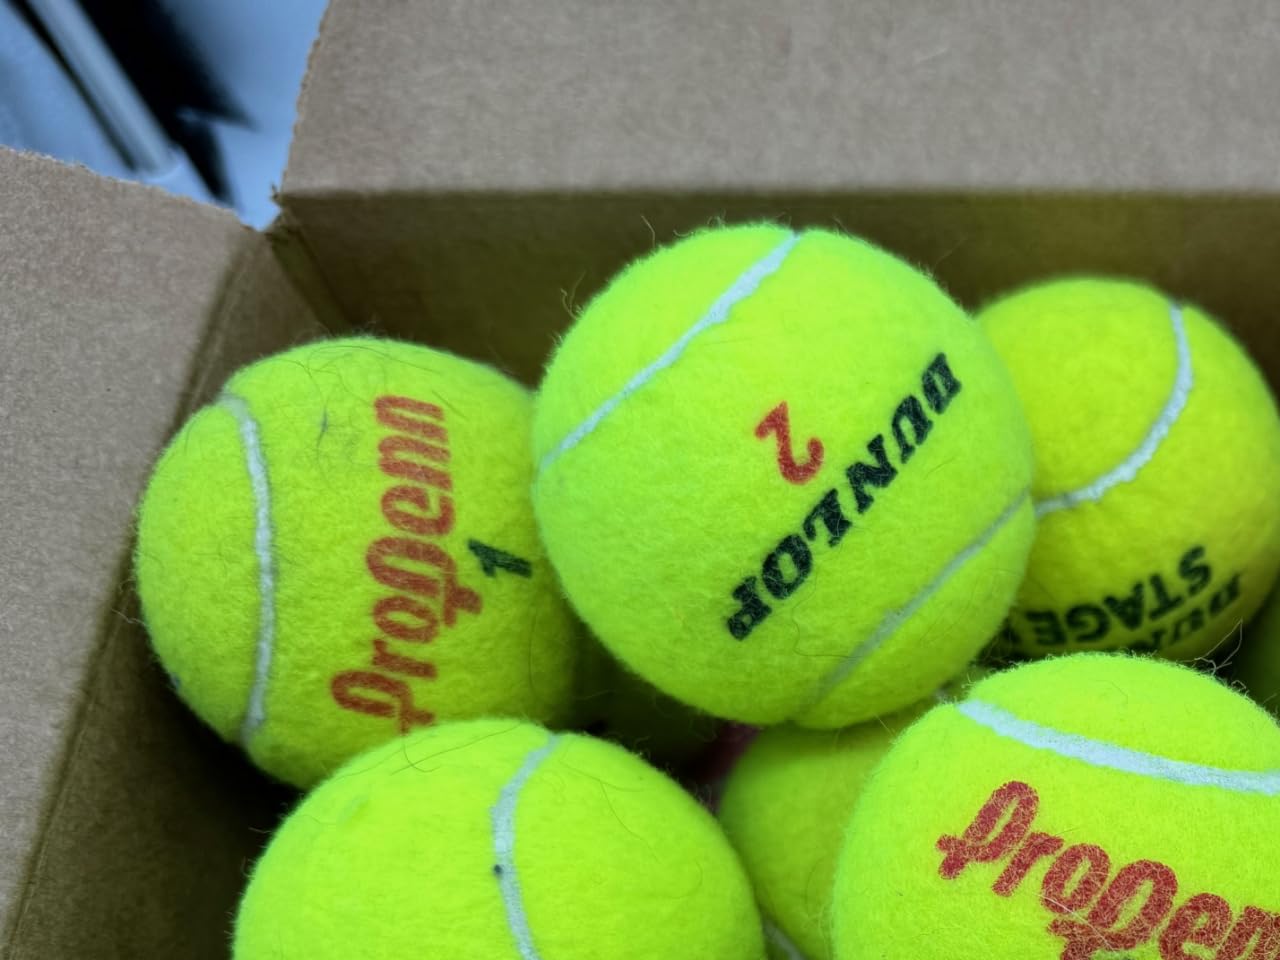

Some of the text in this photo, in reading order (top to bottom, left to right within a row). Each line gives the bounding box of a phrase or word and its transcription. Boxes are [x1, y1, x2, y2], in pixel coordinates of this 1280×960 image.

[755, 401, 824, 486] 2
[726, 352, 962, 642] DUNLOP
[331, 396, 481, 733] ProPenn
[468, 538, 532, 578] 1
[1025, 546, 1211, 646] STAGE
